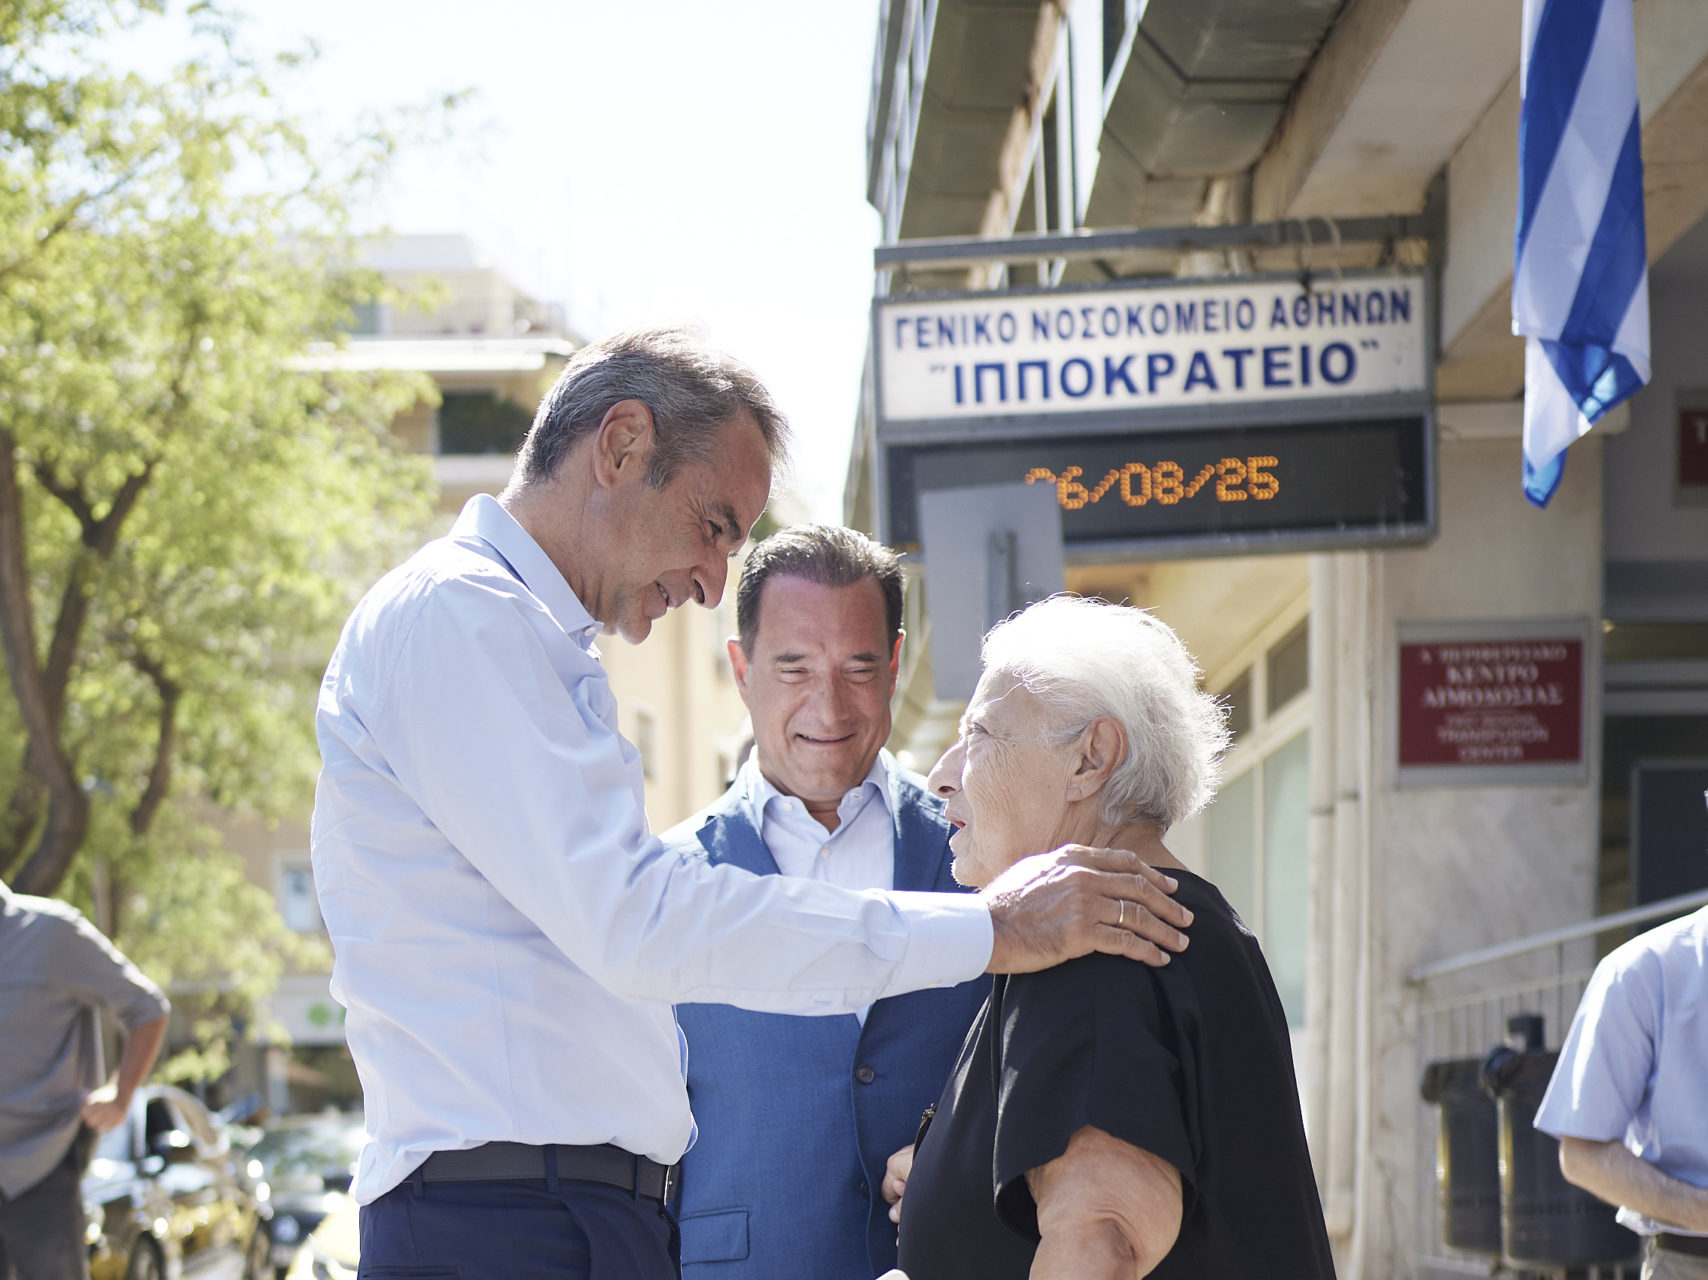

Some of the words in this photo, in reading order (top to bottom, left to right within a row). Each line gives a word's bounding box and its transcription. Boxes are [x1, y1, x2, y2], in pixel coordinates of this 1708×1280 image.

[895, 311, 1017, 350] ΓΕΝΙΚΟ
[1031, 298, 1256, 342] ΝΟΣΟΚΟΜΕΙΟ
[1269, 287, 1413, 330] ΑΘΗΝΩΝ
[1446, 663, 1540, 683] ΚΕΝΤΡΟ
[1423, 684, 1564, 707] ΑΙΜΟΔΟΣΙΑΣ
